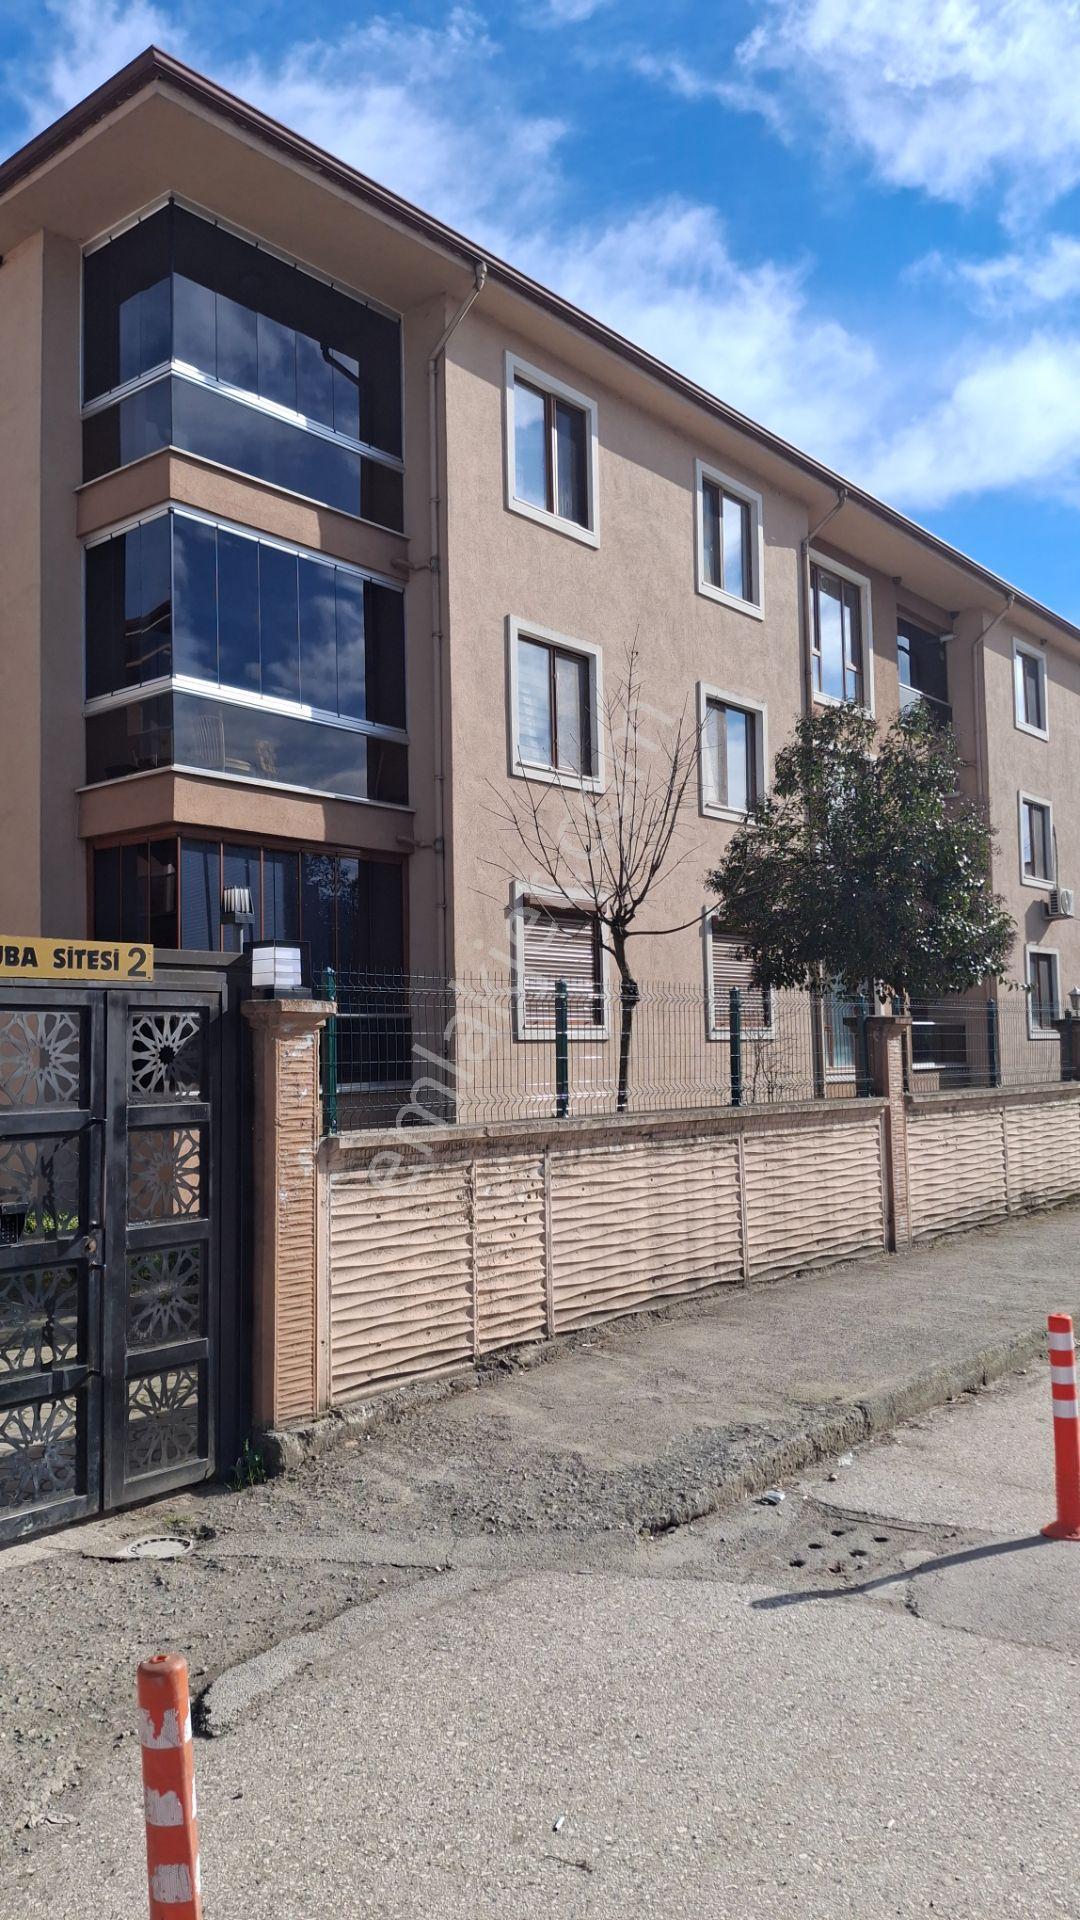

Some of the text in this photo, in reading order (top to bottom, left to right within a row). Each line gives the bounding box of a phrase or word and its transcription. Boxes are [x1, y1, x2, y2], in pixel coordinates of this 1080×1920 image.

[0, 945, 147, 977] BA SİTESİ 2
